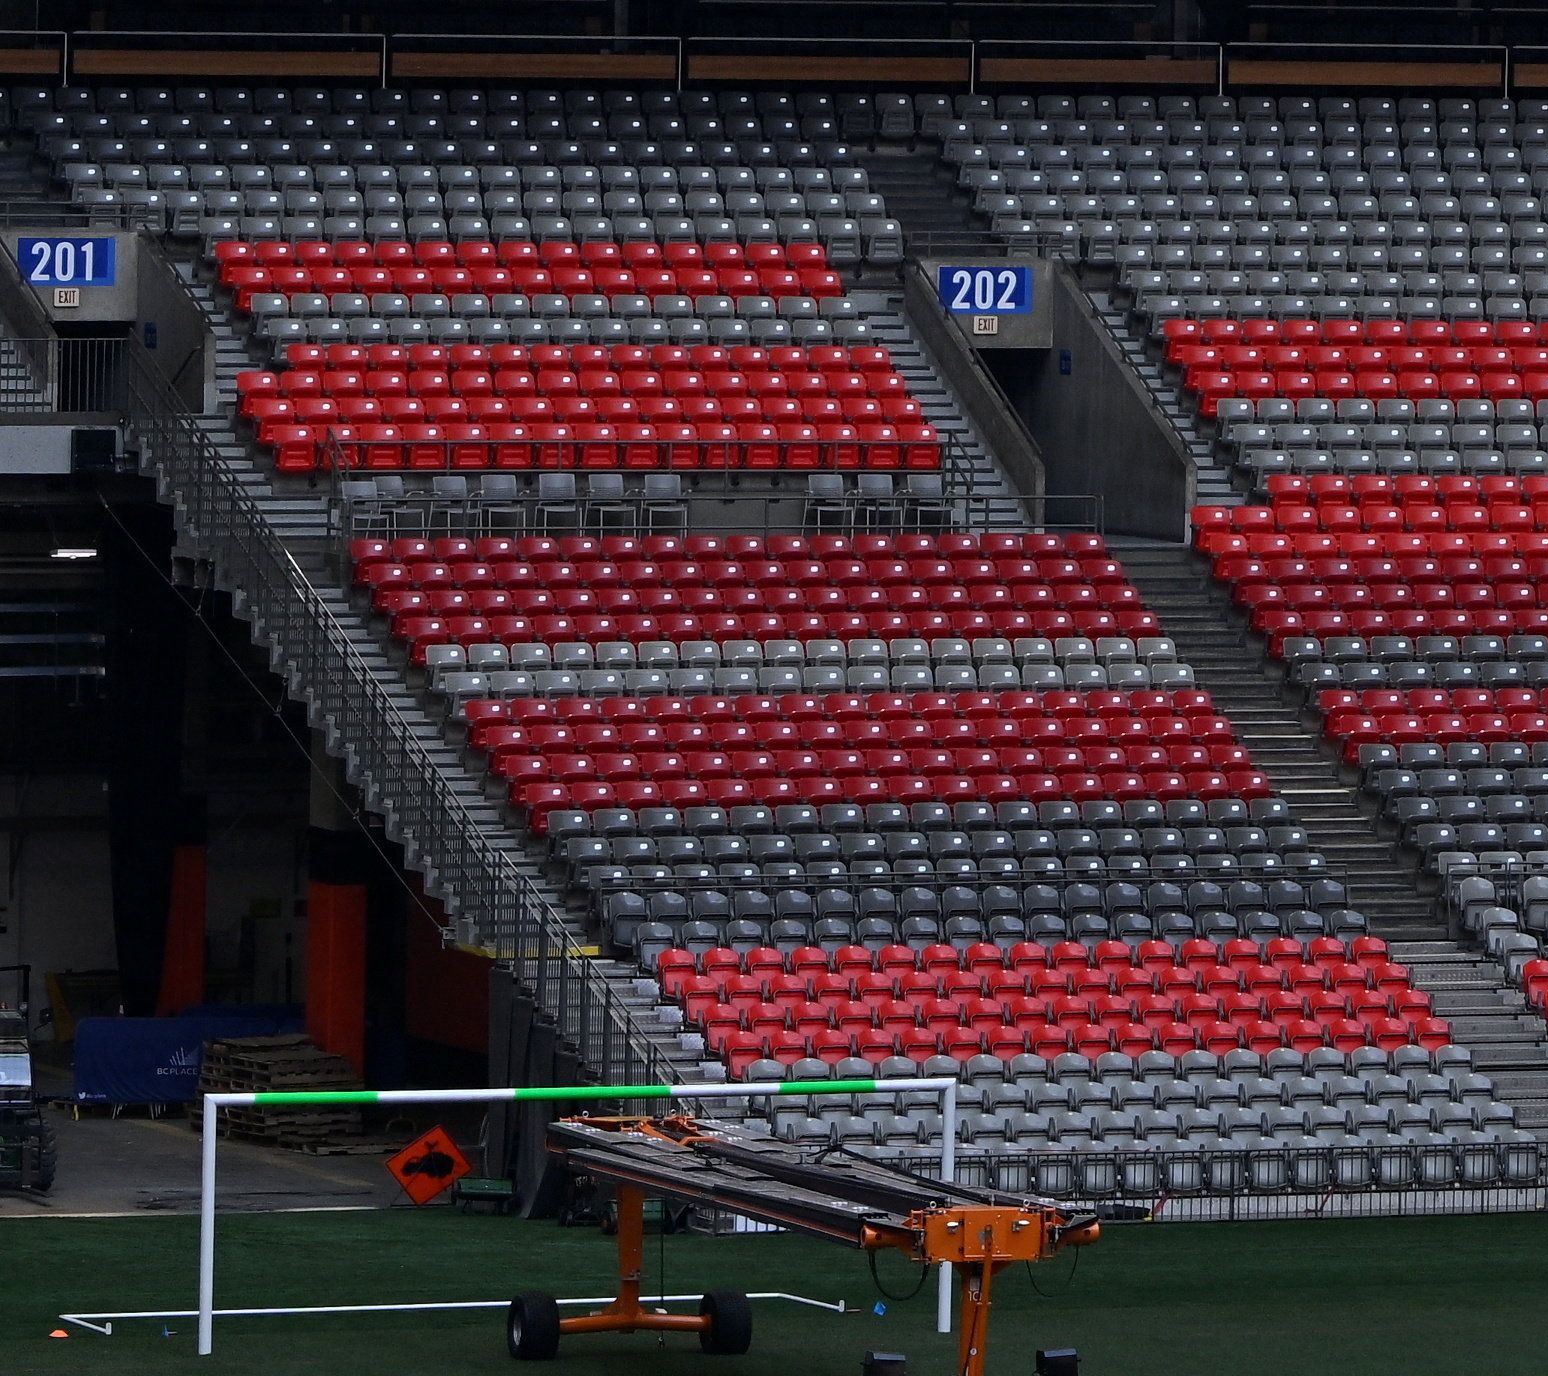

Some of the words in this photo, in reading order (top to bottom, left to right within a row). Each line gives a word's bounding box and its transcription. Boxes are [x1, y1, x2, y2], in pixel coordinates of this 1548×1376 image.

[31, 242, 92, 281] 201
[58, 290, 77, 304] EXIT
[953, 271, 1016, 309] 202
[977, 318, 996, 332] EXIT
[156, 1067, 169, 1075] BC
[170, 1067, 198, 1075] PLACE
